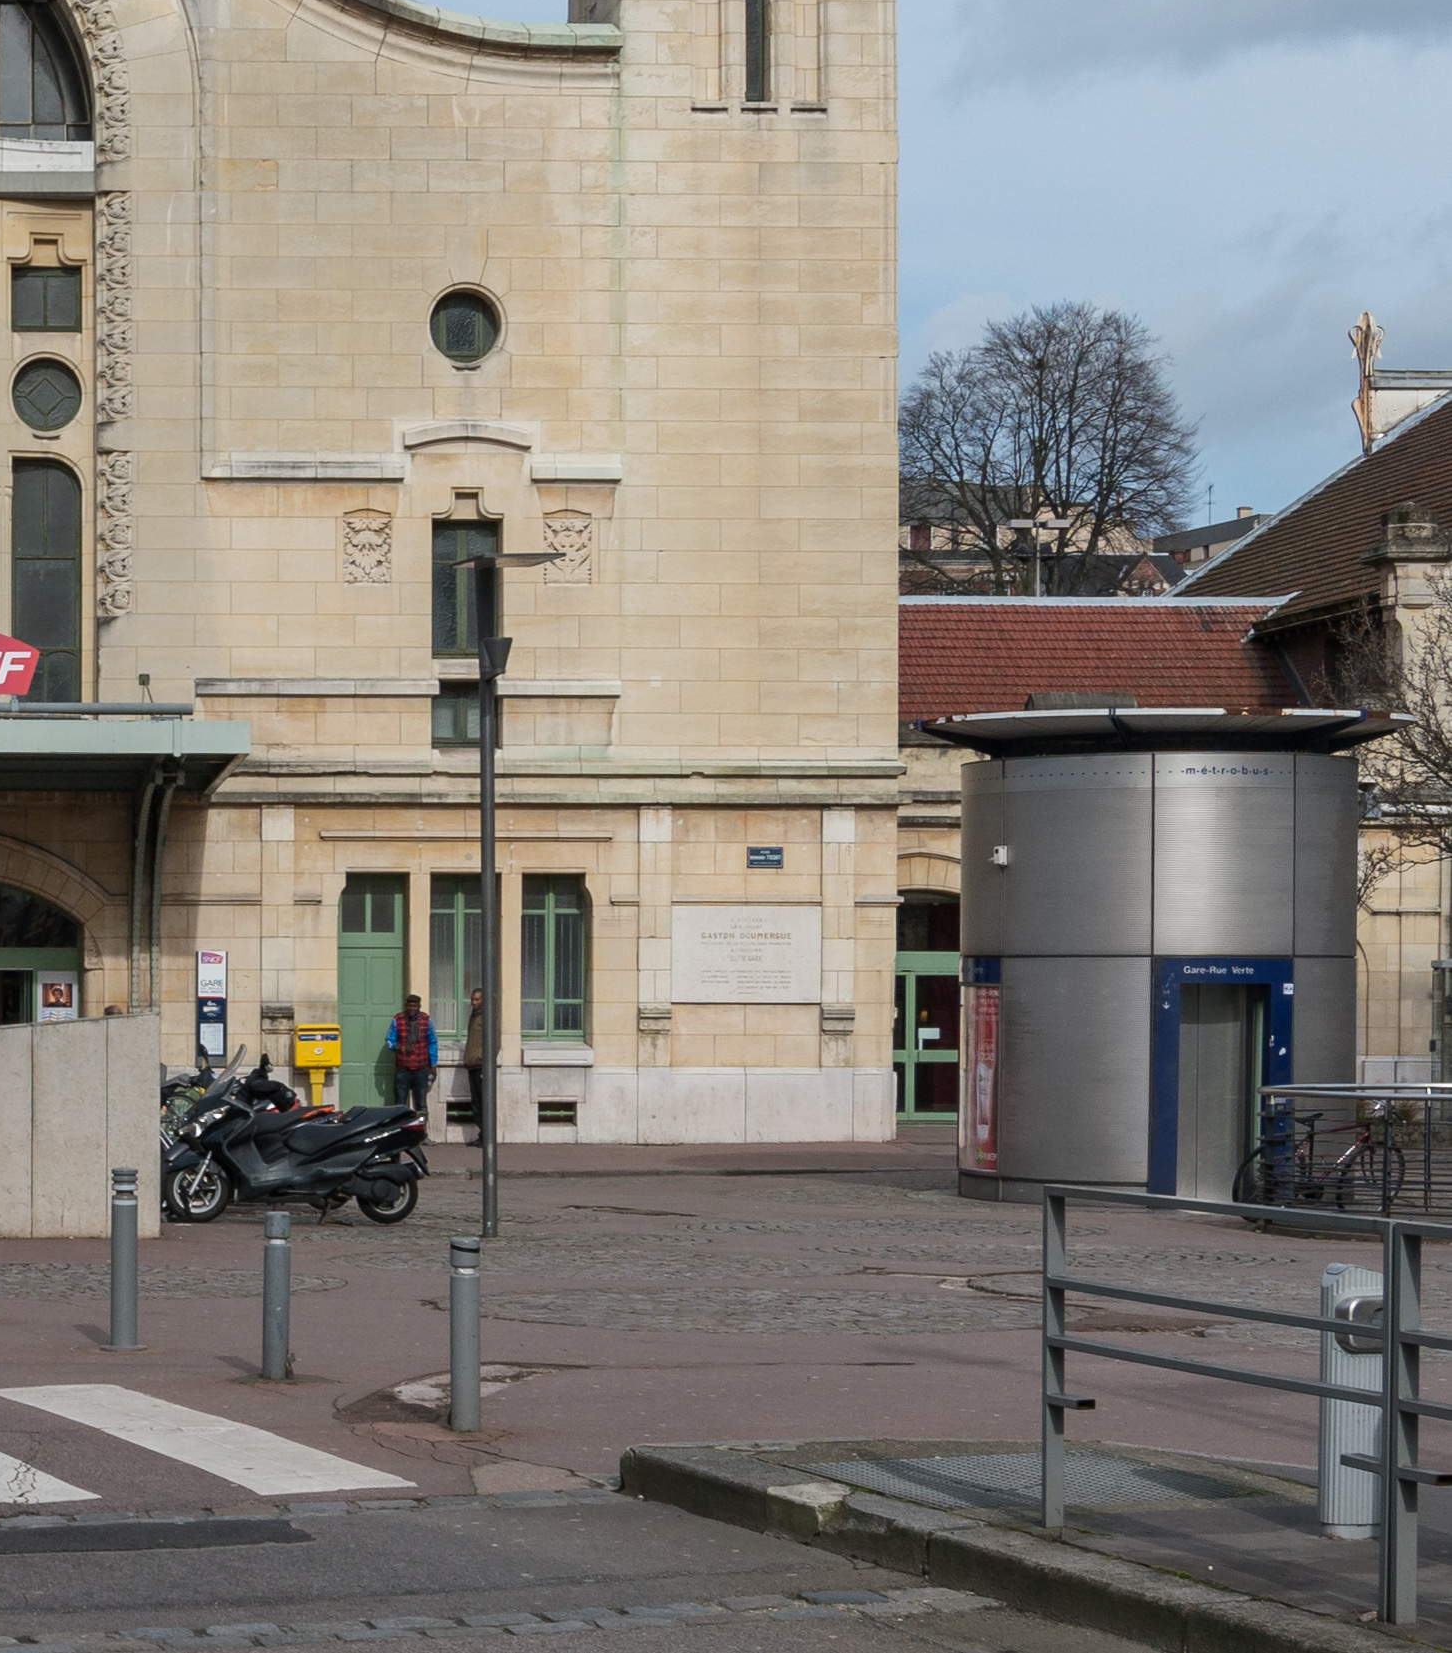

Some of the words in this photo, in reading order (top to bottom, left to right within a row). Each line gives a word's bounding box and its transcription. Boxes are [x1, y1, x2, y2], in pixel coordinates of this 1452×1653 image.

[701, 932, 735, 940] GASTON
[740, 932, 792, 940] DOUMERGUE
[1183, 965, 1227, 974] Gare-Rue
[1231, 965, 1254, 974] Verte
[201, 979, 223, 987] GARE
